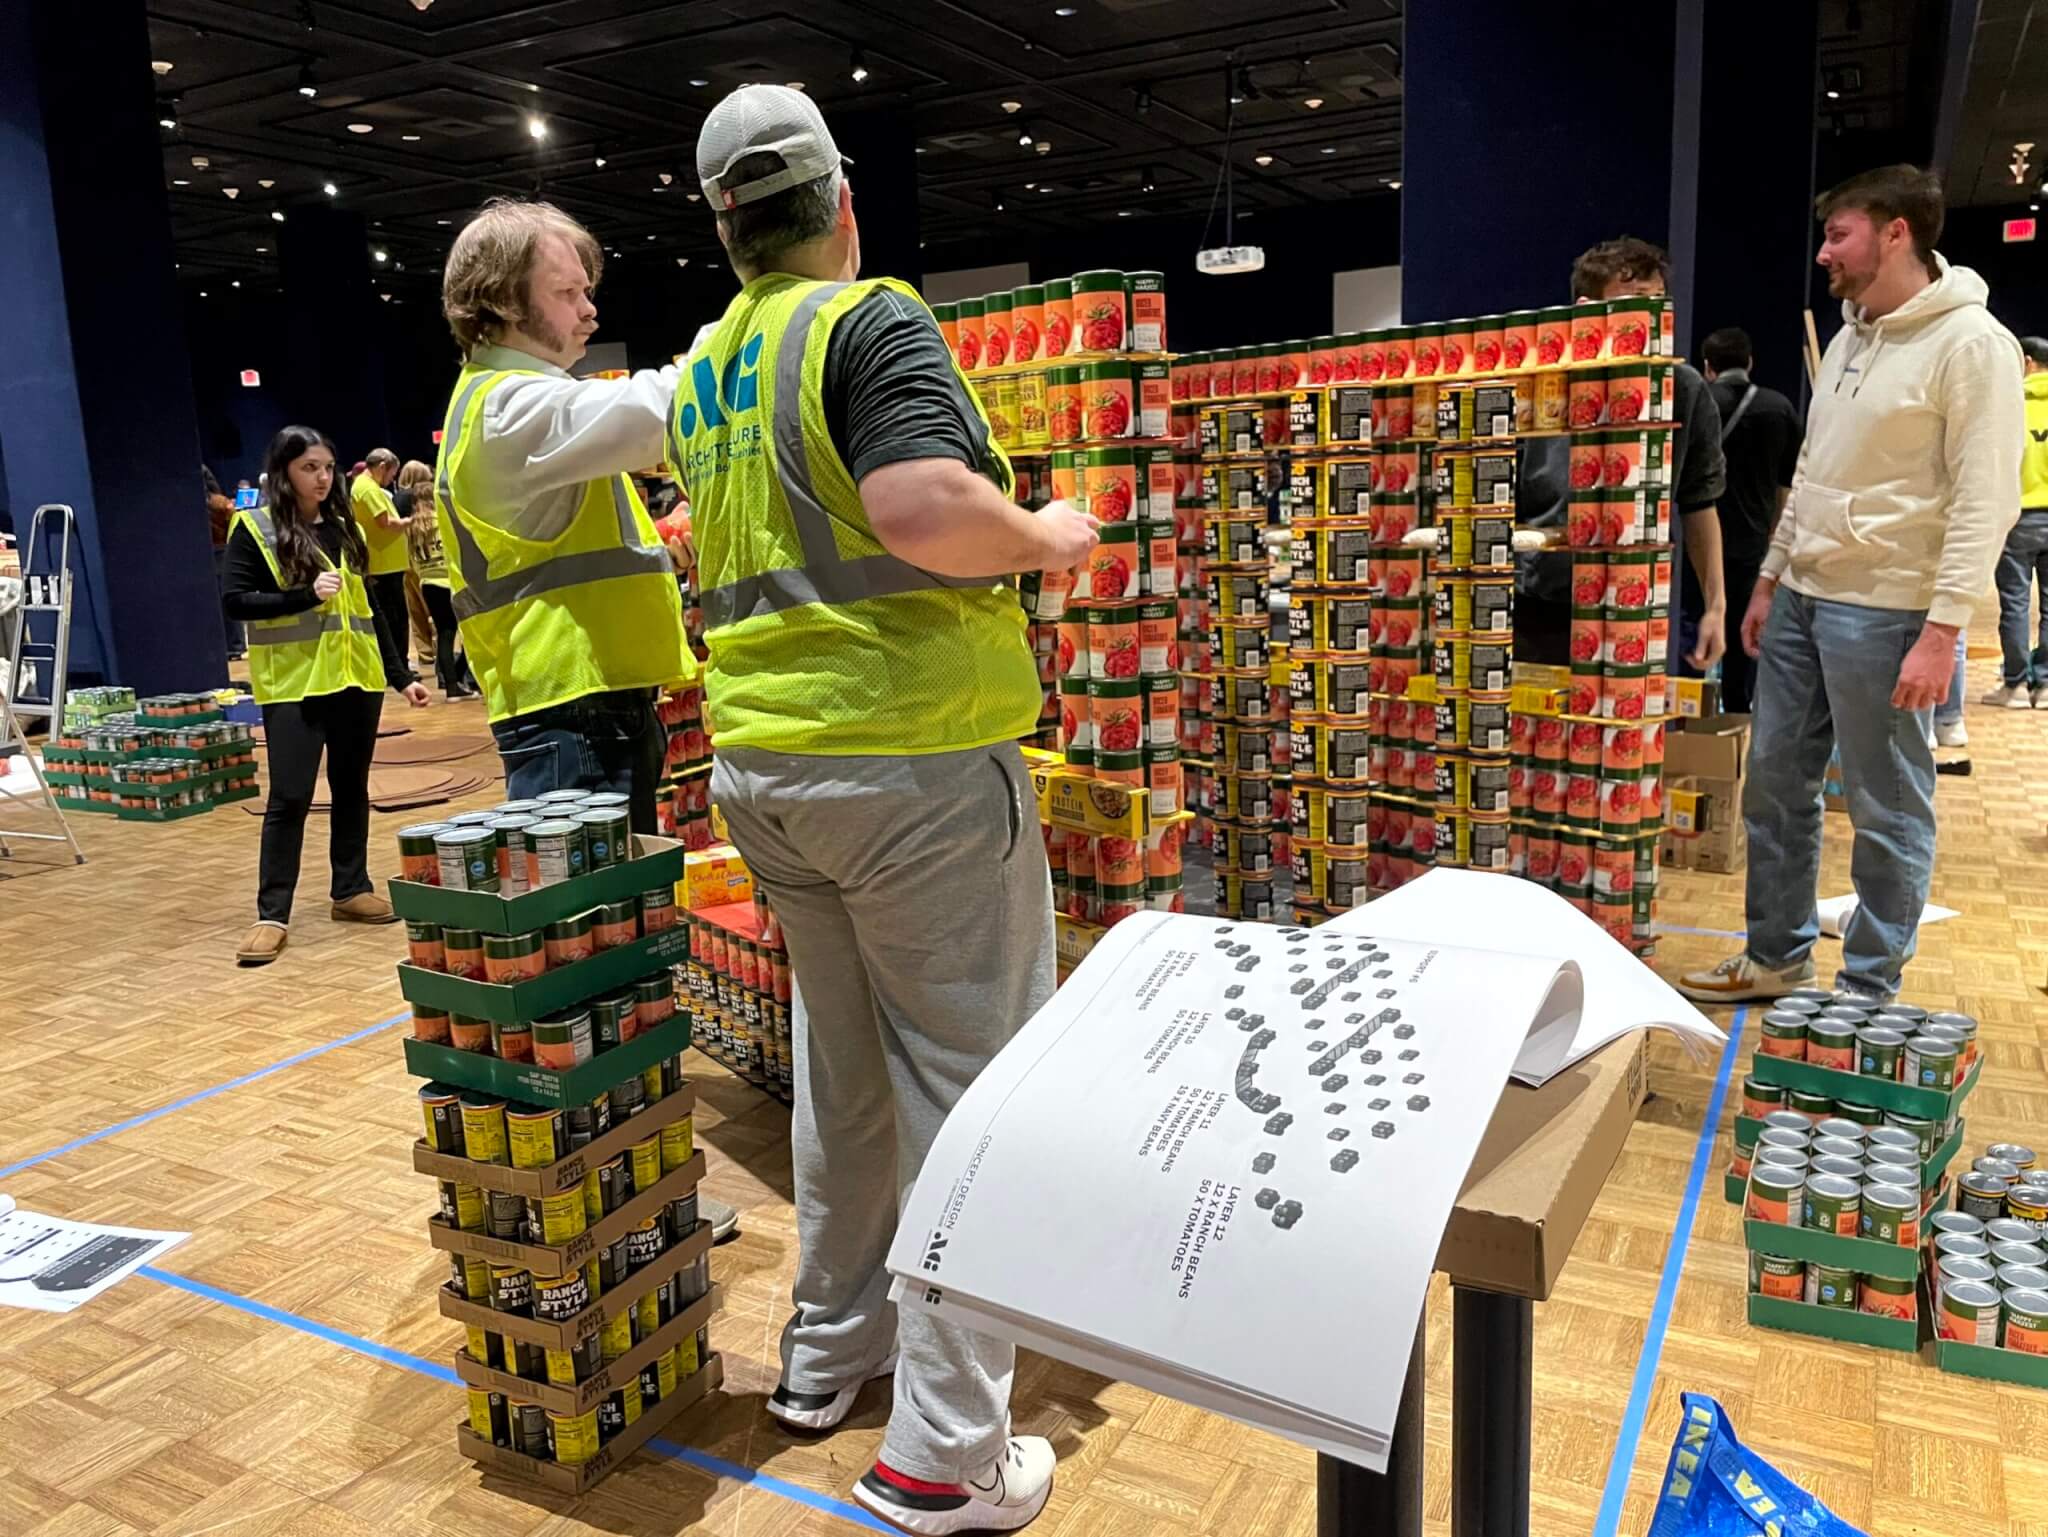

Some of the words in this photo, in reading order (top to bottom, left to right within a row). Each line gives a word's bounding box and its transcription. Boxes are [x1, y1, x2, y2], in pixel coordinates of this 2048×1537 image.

[1144, 1024, 1176, 1060] TOMATOES
[1184, 1098, 1194, 1106] X
[1190, 1087, 1202, 1098] 50
[1203, 1089, 1215, 1101] 12
[1157, 1103, 1177, 1125] NAVY
[1207, 1092, 1229, 1118] LAYER
[1156, 1106, 1190, 1152] TOMATOES
[1178, 1108, 1203, 1138] RANCH
[1198, 1118, 1212, 1130] 11
[1138, 1124, 1162, 1157] BEANS
[966, 1134, 993, 1184] CONCEPT
[1161, 1139, 1184, 1174] BEANS
[1200, 1179, 1212, 1194] 50
[1213, 1181, 1225, 1197] 12
[945, 1184, 969, 1231] DESIGN
[1194, 1195, 1205, 1205] X
[1209, 1199, 1220, 1209] X
[1219, 1186, 1241, 1222] LAYER
[628, 1227, 660, 1245] ANCH
[1171, 1206, 1202, 1272] TOMATOES
[1193, 1209, 1215, 1253] RANCH
[1213, 1224, 1226, 1241] 12
[628, 1236, 663, 1256] TYLE
[501, 1274, 529, 1288] RAN
[1178, 1255, 1200, 1300] BEANS
[498, 1285, 530, 1299] STY
[540, 1288, 588, 1311] STYLE
[543, 1279, 585, 1300] RANCH
